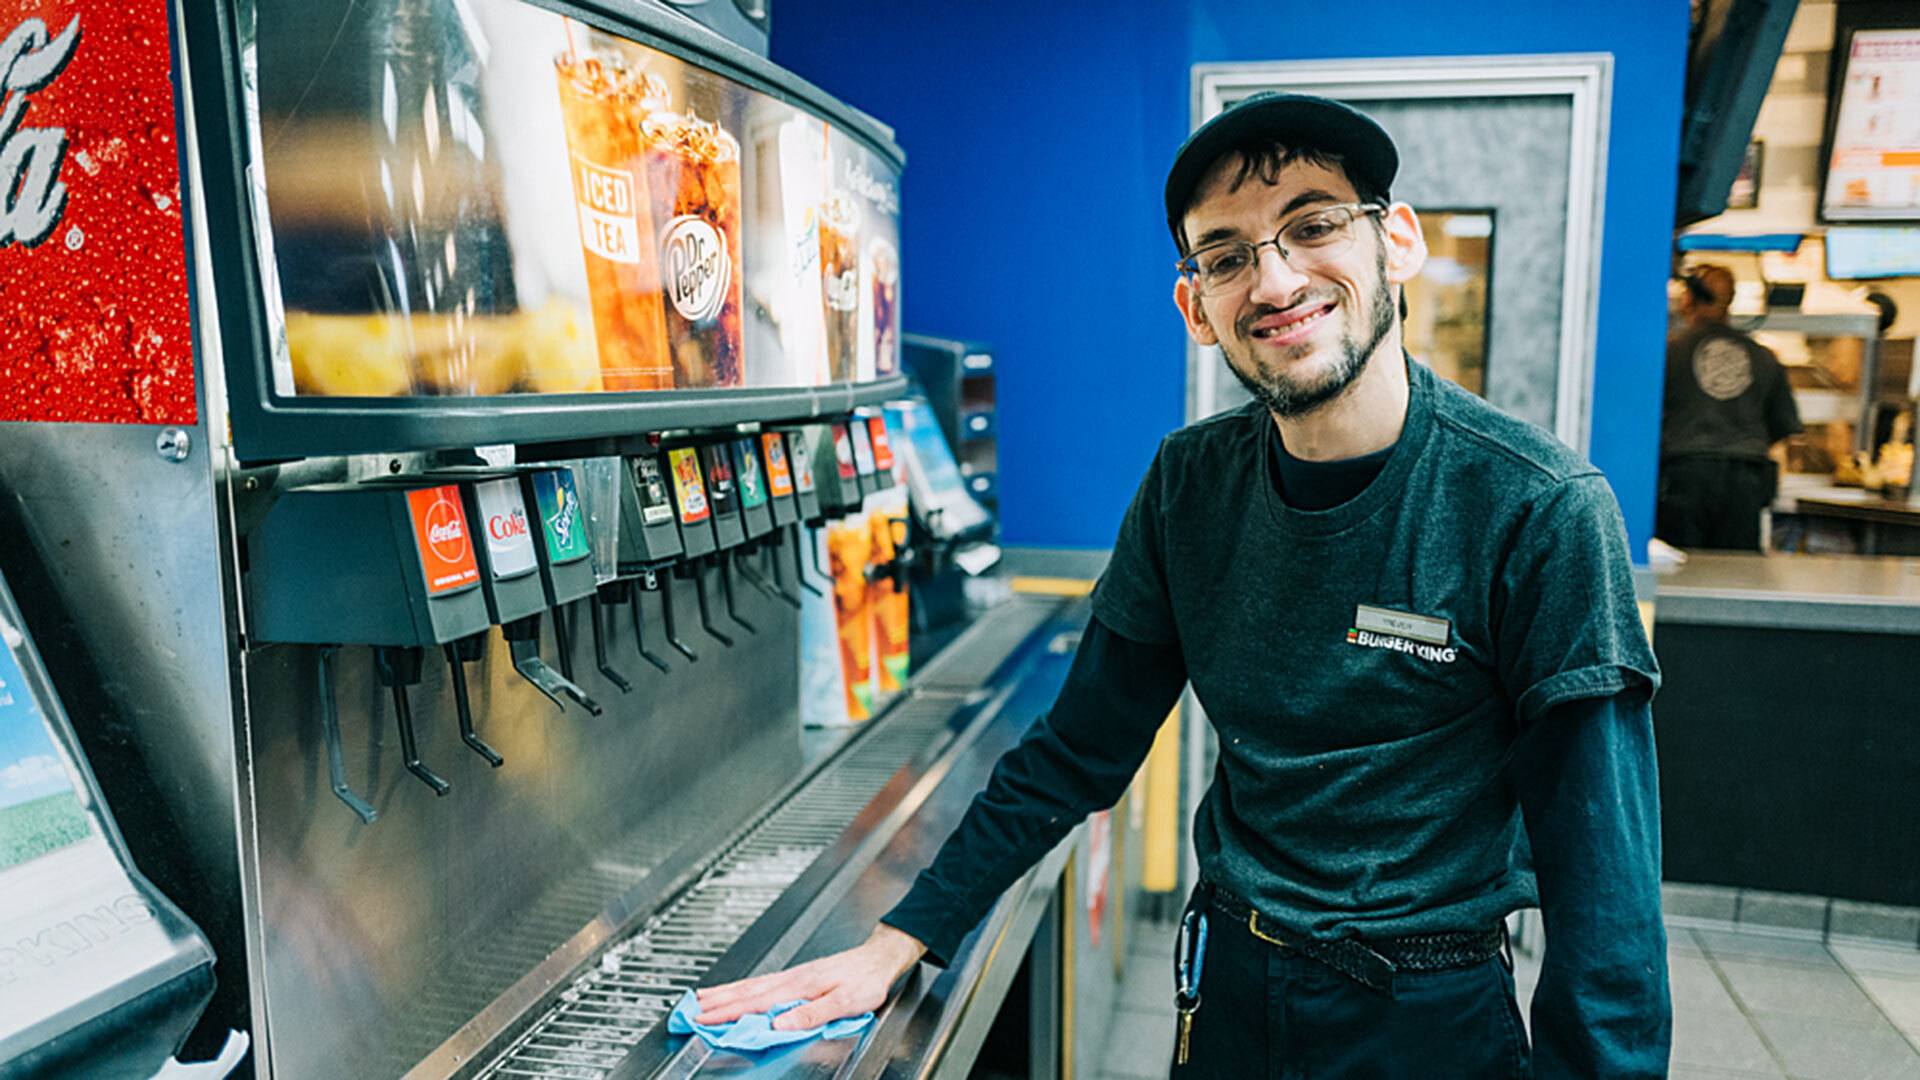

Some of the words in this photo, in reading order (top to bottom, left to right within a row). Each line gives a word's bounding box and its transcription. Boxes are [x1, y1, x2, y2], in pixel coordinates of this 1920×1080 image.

[582, 168, 628, 213] ICED
[593, 217, 627, 256] TEA
[685, 232, 705, 267] Dr
[670, 237, 717, 305] Pepper
[489, 513, 527, 541] Coke
